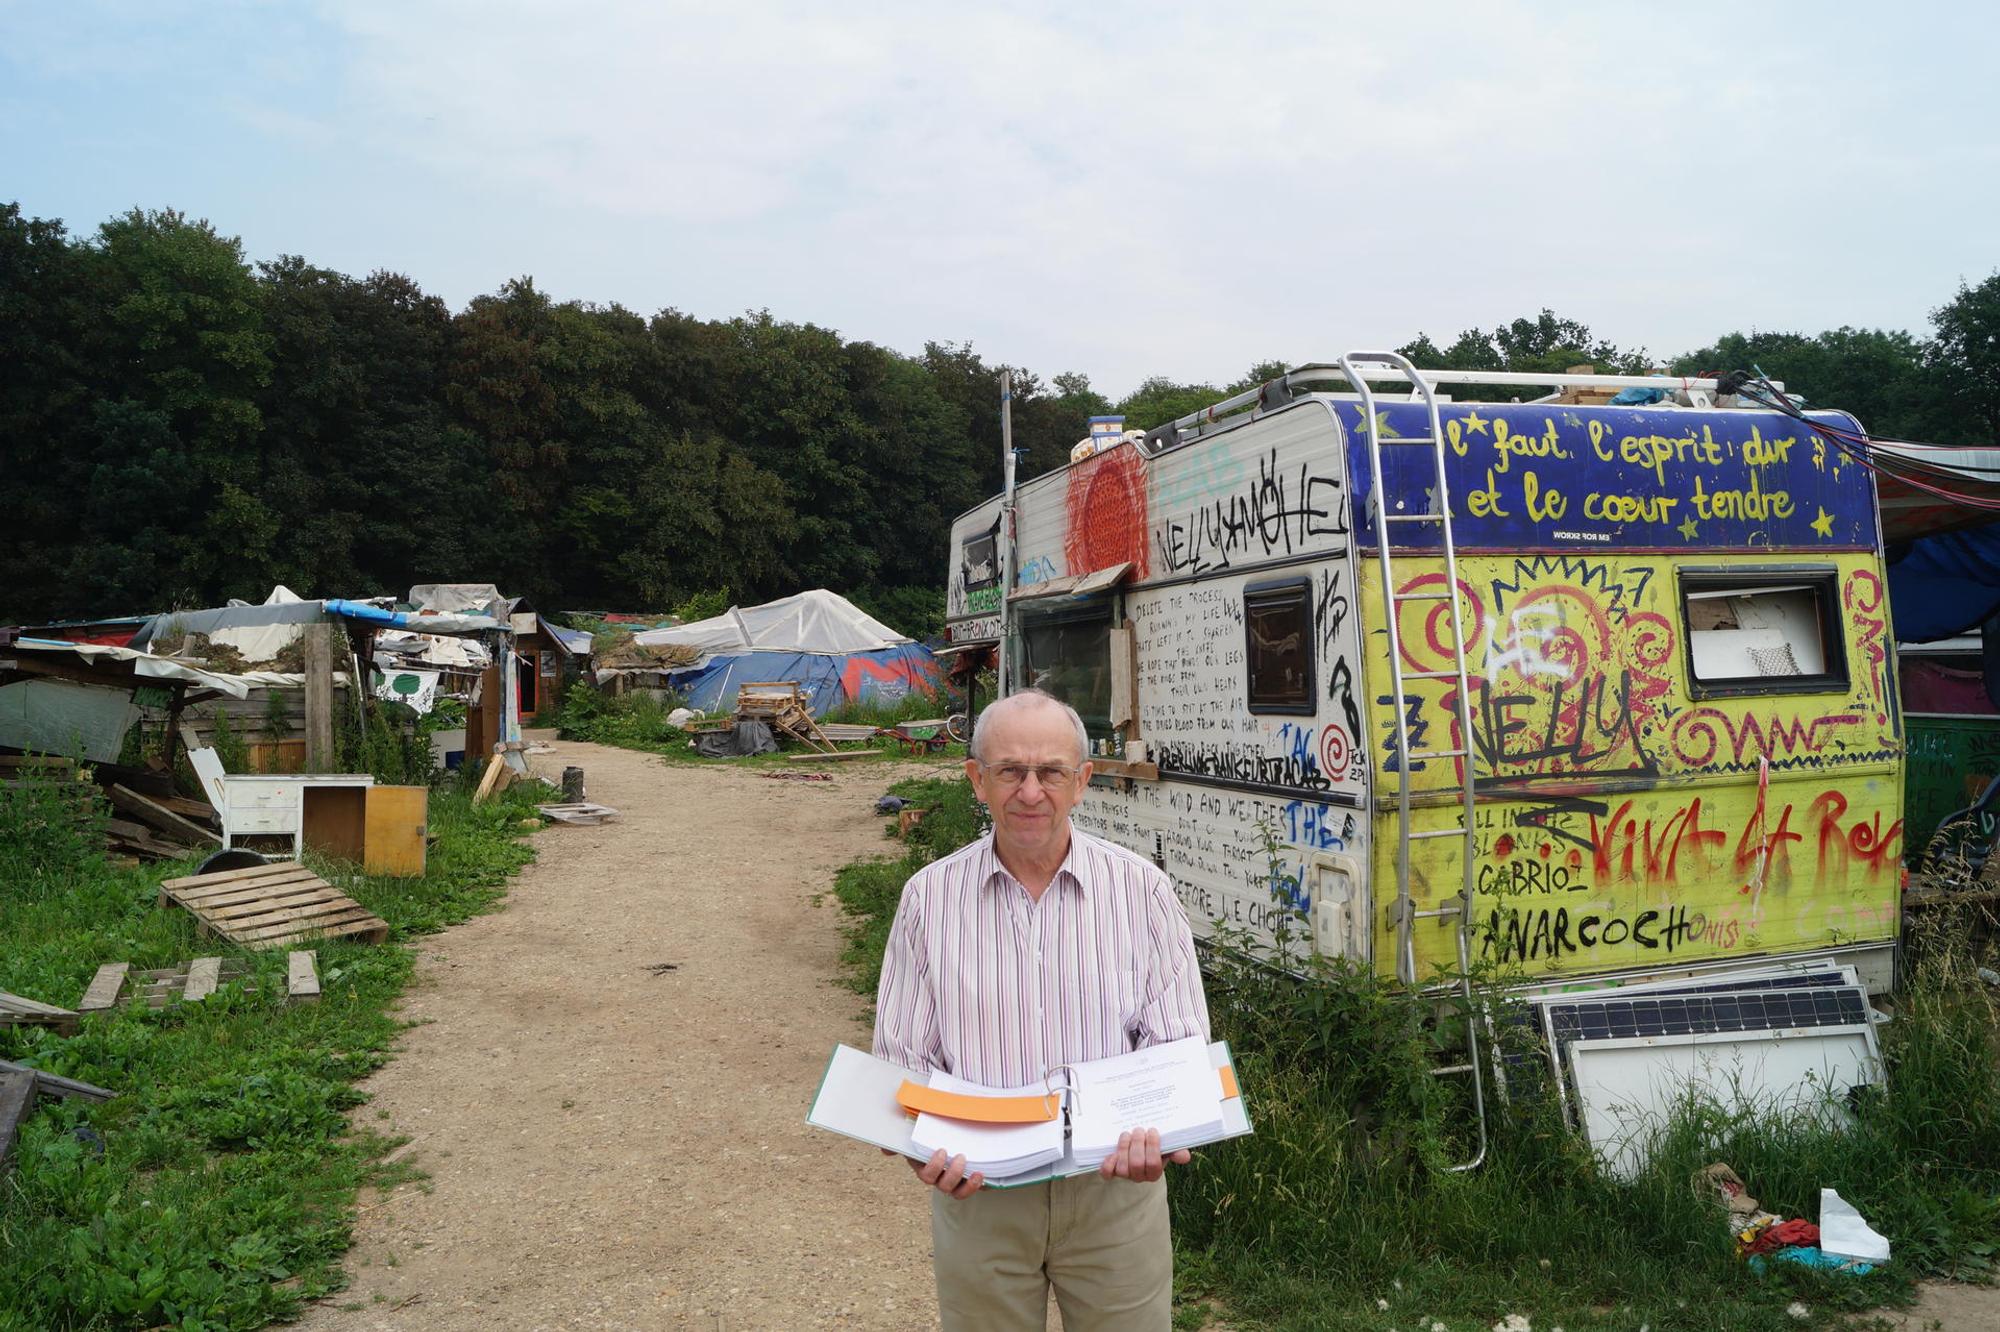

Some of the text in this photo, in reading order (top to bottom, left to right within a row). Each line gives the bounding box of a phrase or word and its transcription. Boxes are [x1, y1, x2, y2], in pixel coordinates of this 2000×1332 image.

[1492, 417, 1568, 473] faut
[1588, 419, 1723, 486] l'esprit
[1742, 424, 1796, 466] dur
[1467, 468, 1510, 518] et
[1523, 470, 1567, 523] le
[1690, 468, 1796, 522] tendre
[1136, 600, 1162, 622] DELETE
[1199, 792, 1221, 819] AND
